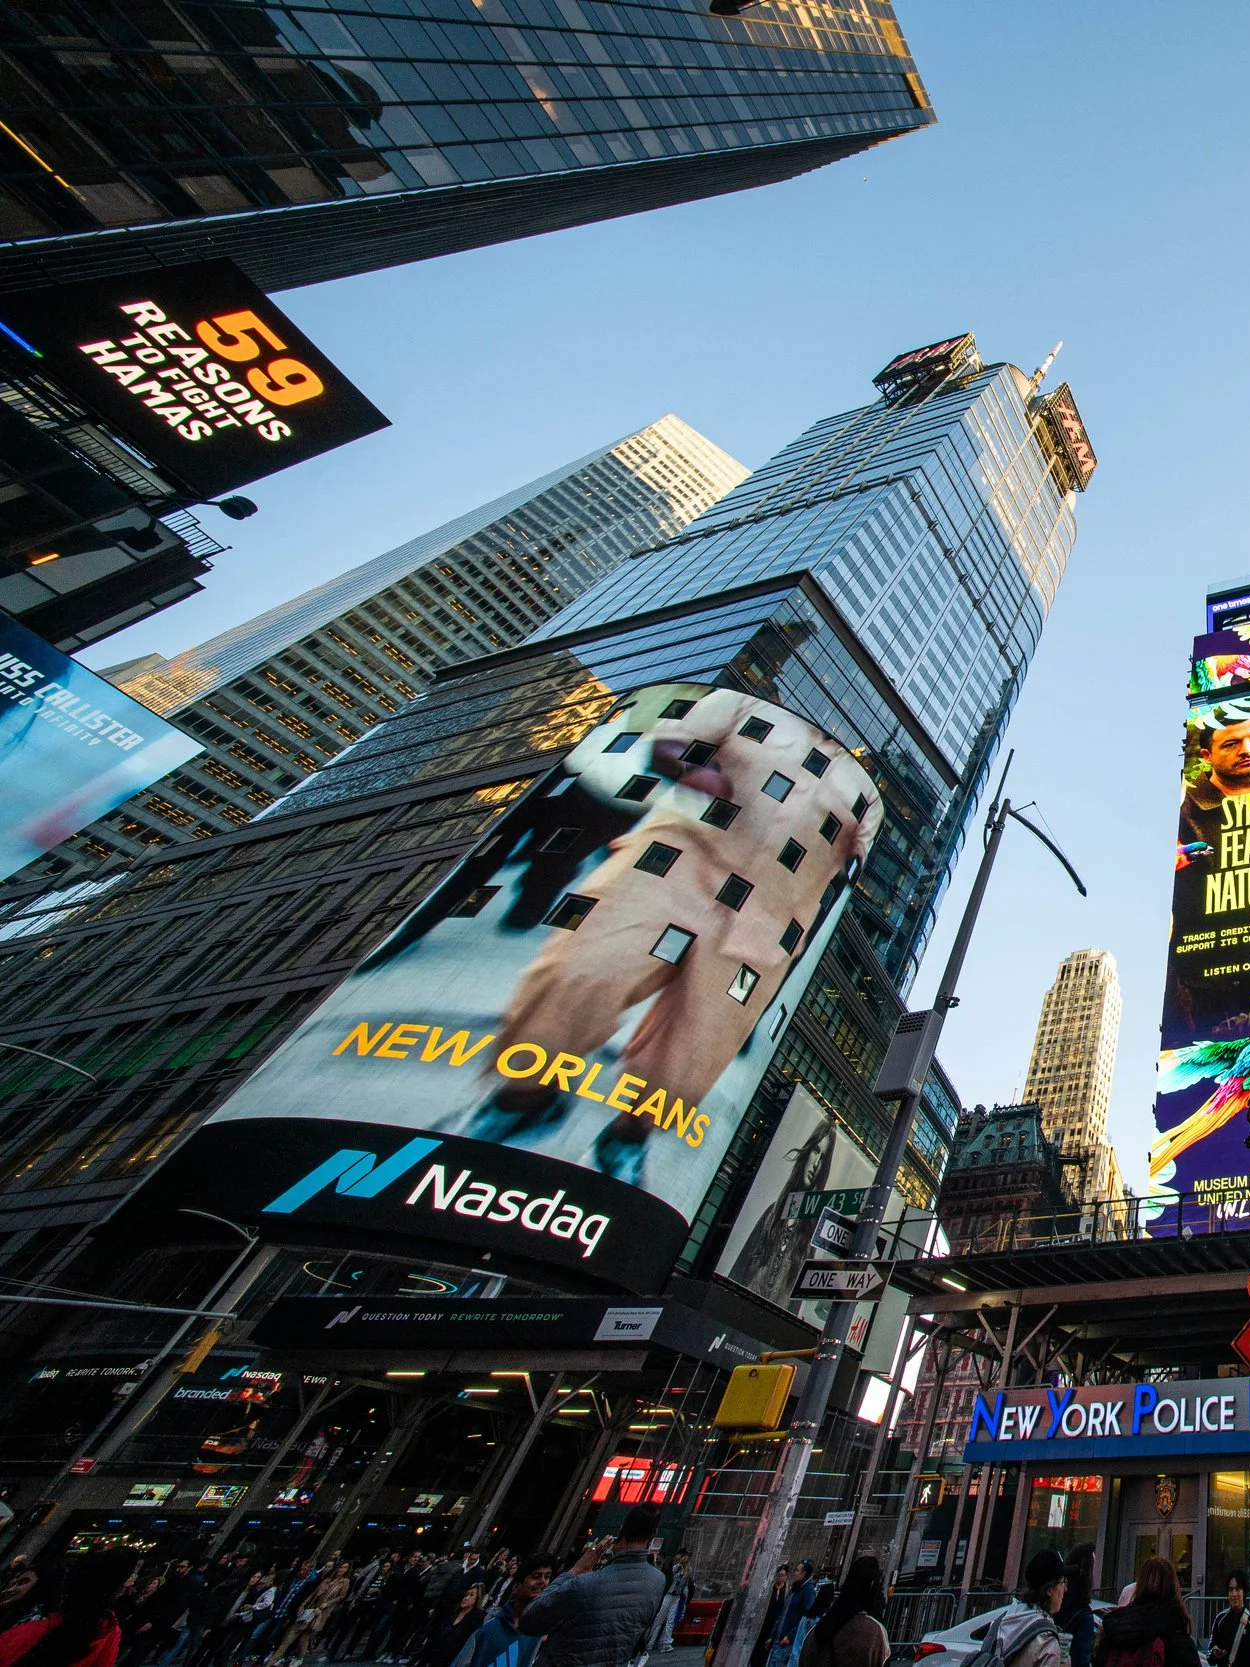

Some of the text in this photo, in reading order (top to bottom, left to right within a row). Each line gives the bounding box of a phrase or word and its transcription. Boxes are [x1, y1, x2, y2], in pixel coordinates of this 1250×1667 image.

[197, 310, 323, 406] 59
[120, 301, 292, 441] REASONS
[120, 332, 243, 429] TO FIGHT
[79, 340, 214, 441] HAMAS
[1212, 603, 1228, 612] one
[1228, 596, 1250, 608] times
[34, 682, 145, 751] CALLISTER
[34, 706, 102, 746] INFINITY
[1176, 940, 1216, 953] SUPPORT
[1220, 937, 1238, 947] ITS
[1182, 931, 1216, 943] TRACKS
[1203, 964, 1240, 977] LISTEN
[332, 1021, 713, 1148] NEW ORLEANS
[1193, 1175, 1248, 1192] MUSEUM
[804, 1194, 821, 1215] W
[826, 1193, 846, 1212] 43
[1197, 1190, 1243, 1206] UNITED
[406, 1163, 611, 1258] Nasdaq
[827, 1224, 849, 1246] ONE
[808, 1272, 876, 1289] ONE WAY
[361, 1313, 411, 1321] QUESTION
[413, 1313, 445, 1321] TODAY
[450, 1313, 497, 1321] REWRITE
[614, 1320, 642, 1330] Turner
[724, 1342, 745, 1356] QUESTION
[65, 1368, 100, 1377] REWRITE
[100, 1367, 144, 1376] TOMORR
[240, 1371, 283, 1381] Nasdaq
[173, 1387, 232, 1400] branded
